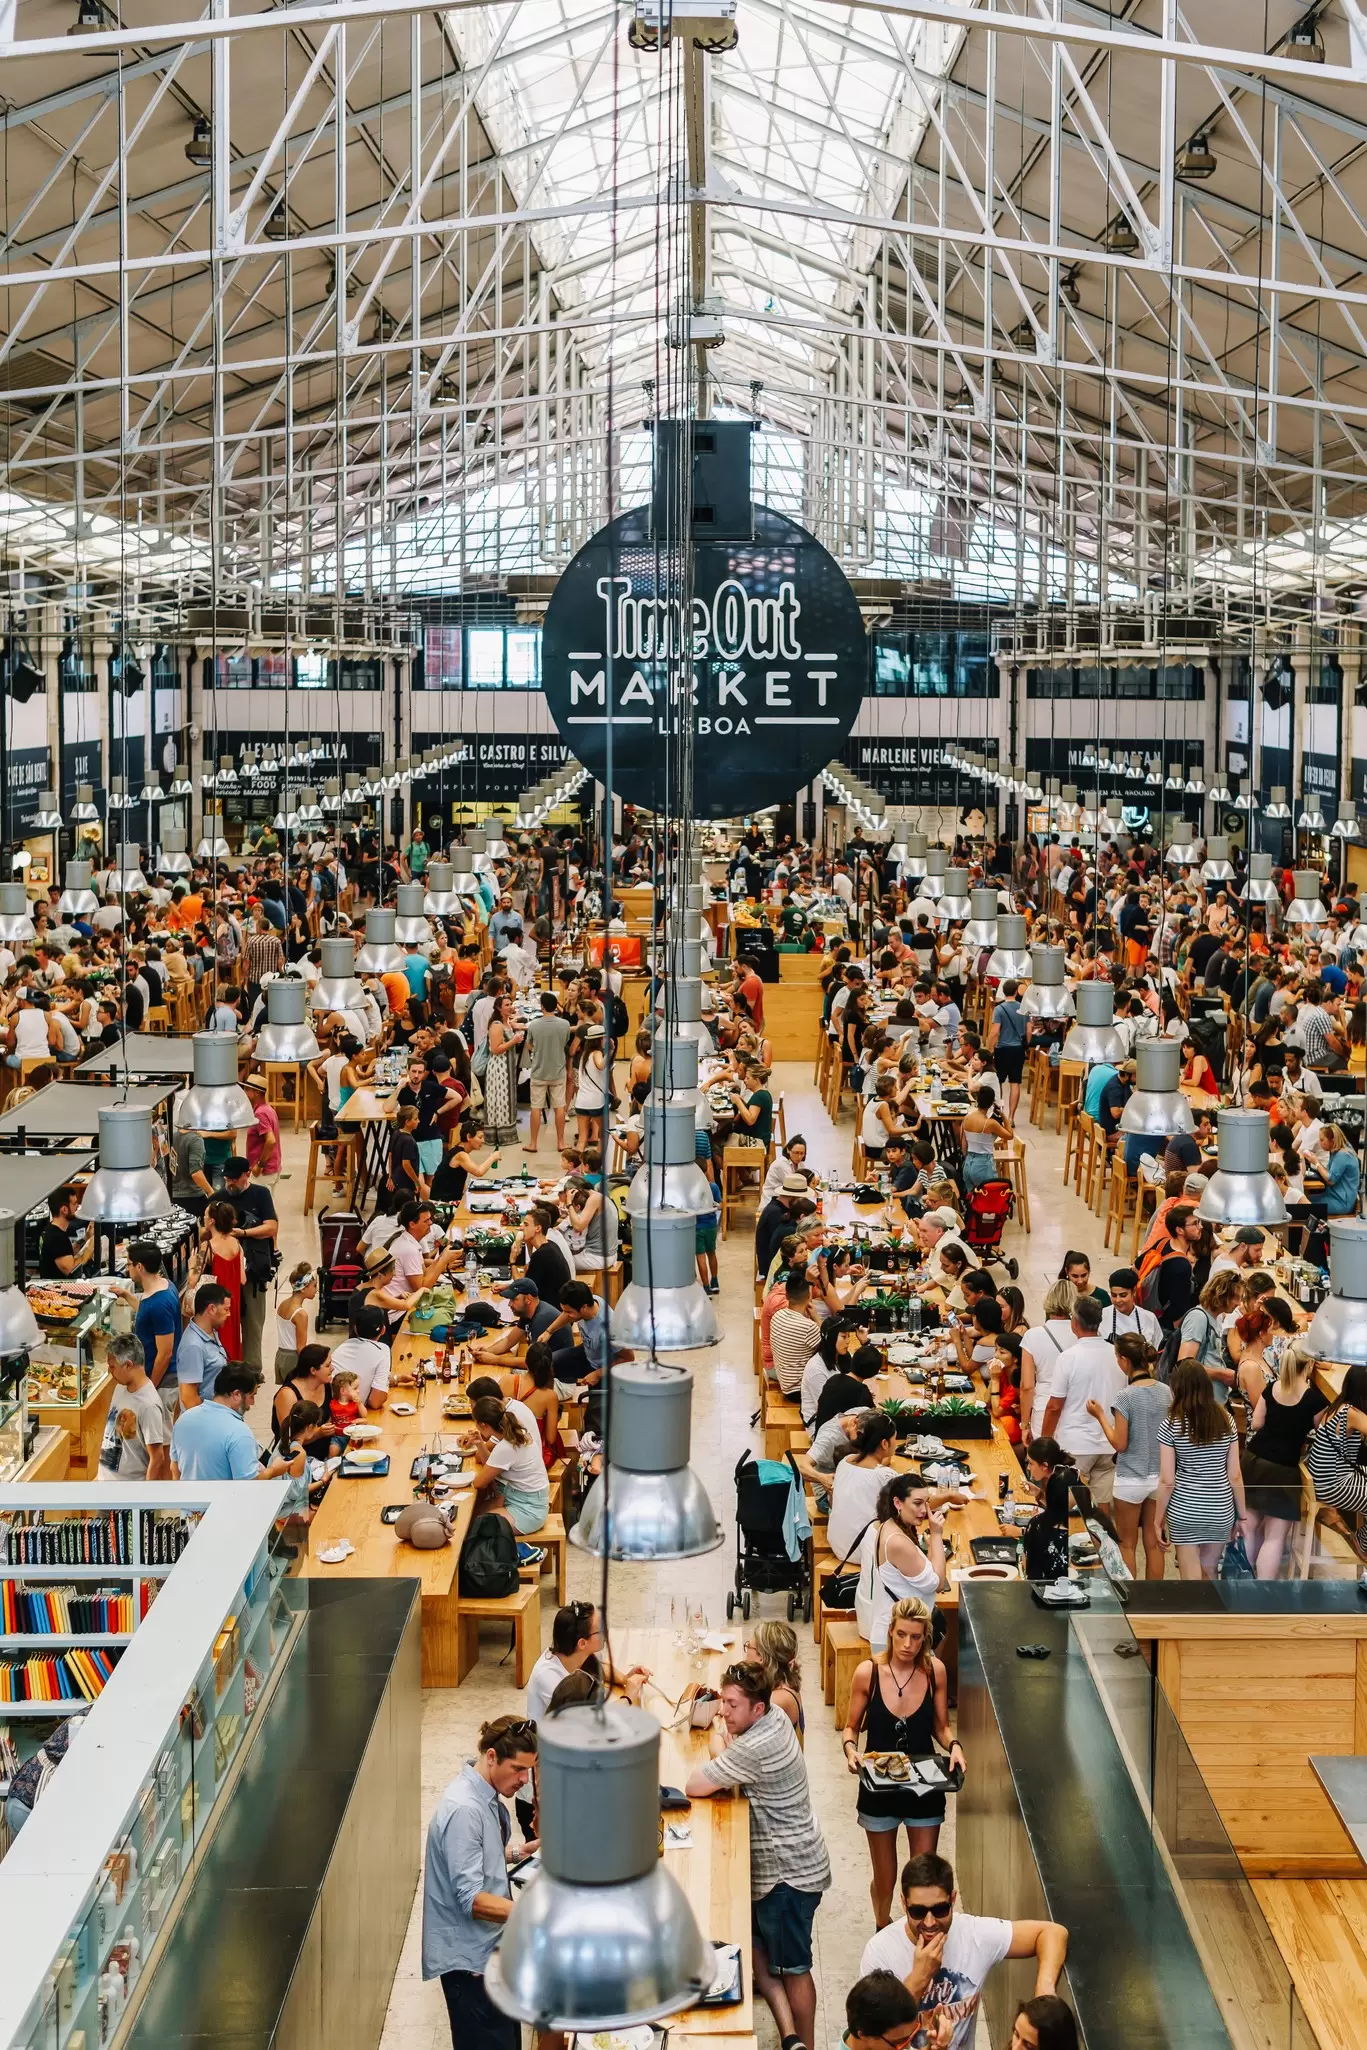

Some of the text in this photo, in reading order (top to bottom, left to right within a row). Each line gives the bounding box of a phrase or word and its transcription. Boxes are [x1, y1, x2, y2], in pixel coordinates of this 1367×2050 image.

[570, 670, 838, 706] MARKET
[318, 743, 348, 758] ILVA
[479, 744, 525, 760] CASTRO
[529, 745, 537, 760] E
[862, 748, 947, 764] MARLENE VIEI
[251, 781, 277, 789] FOOD
